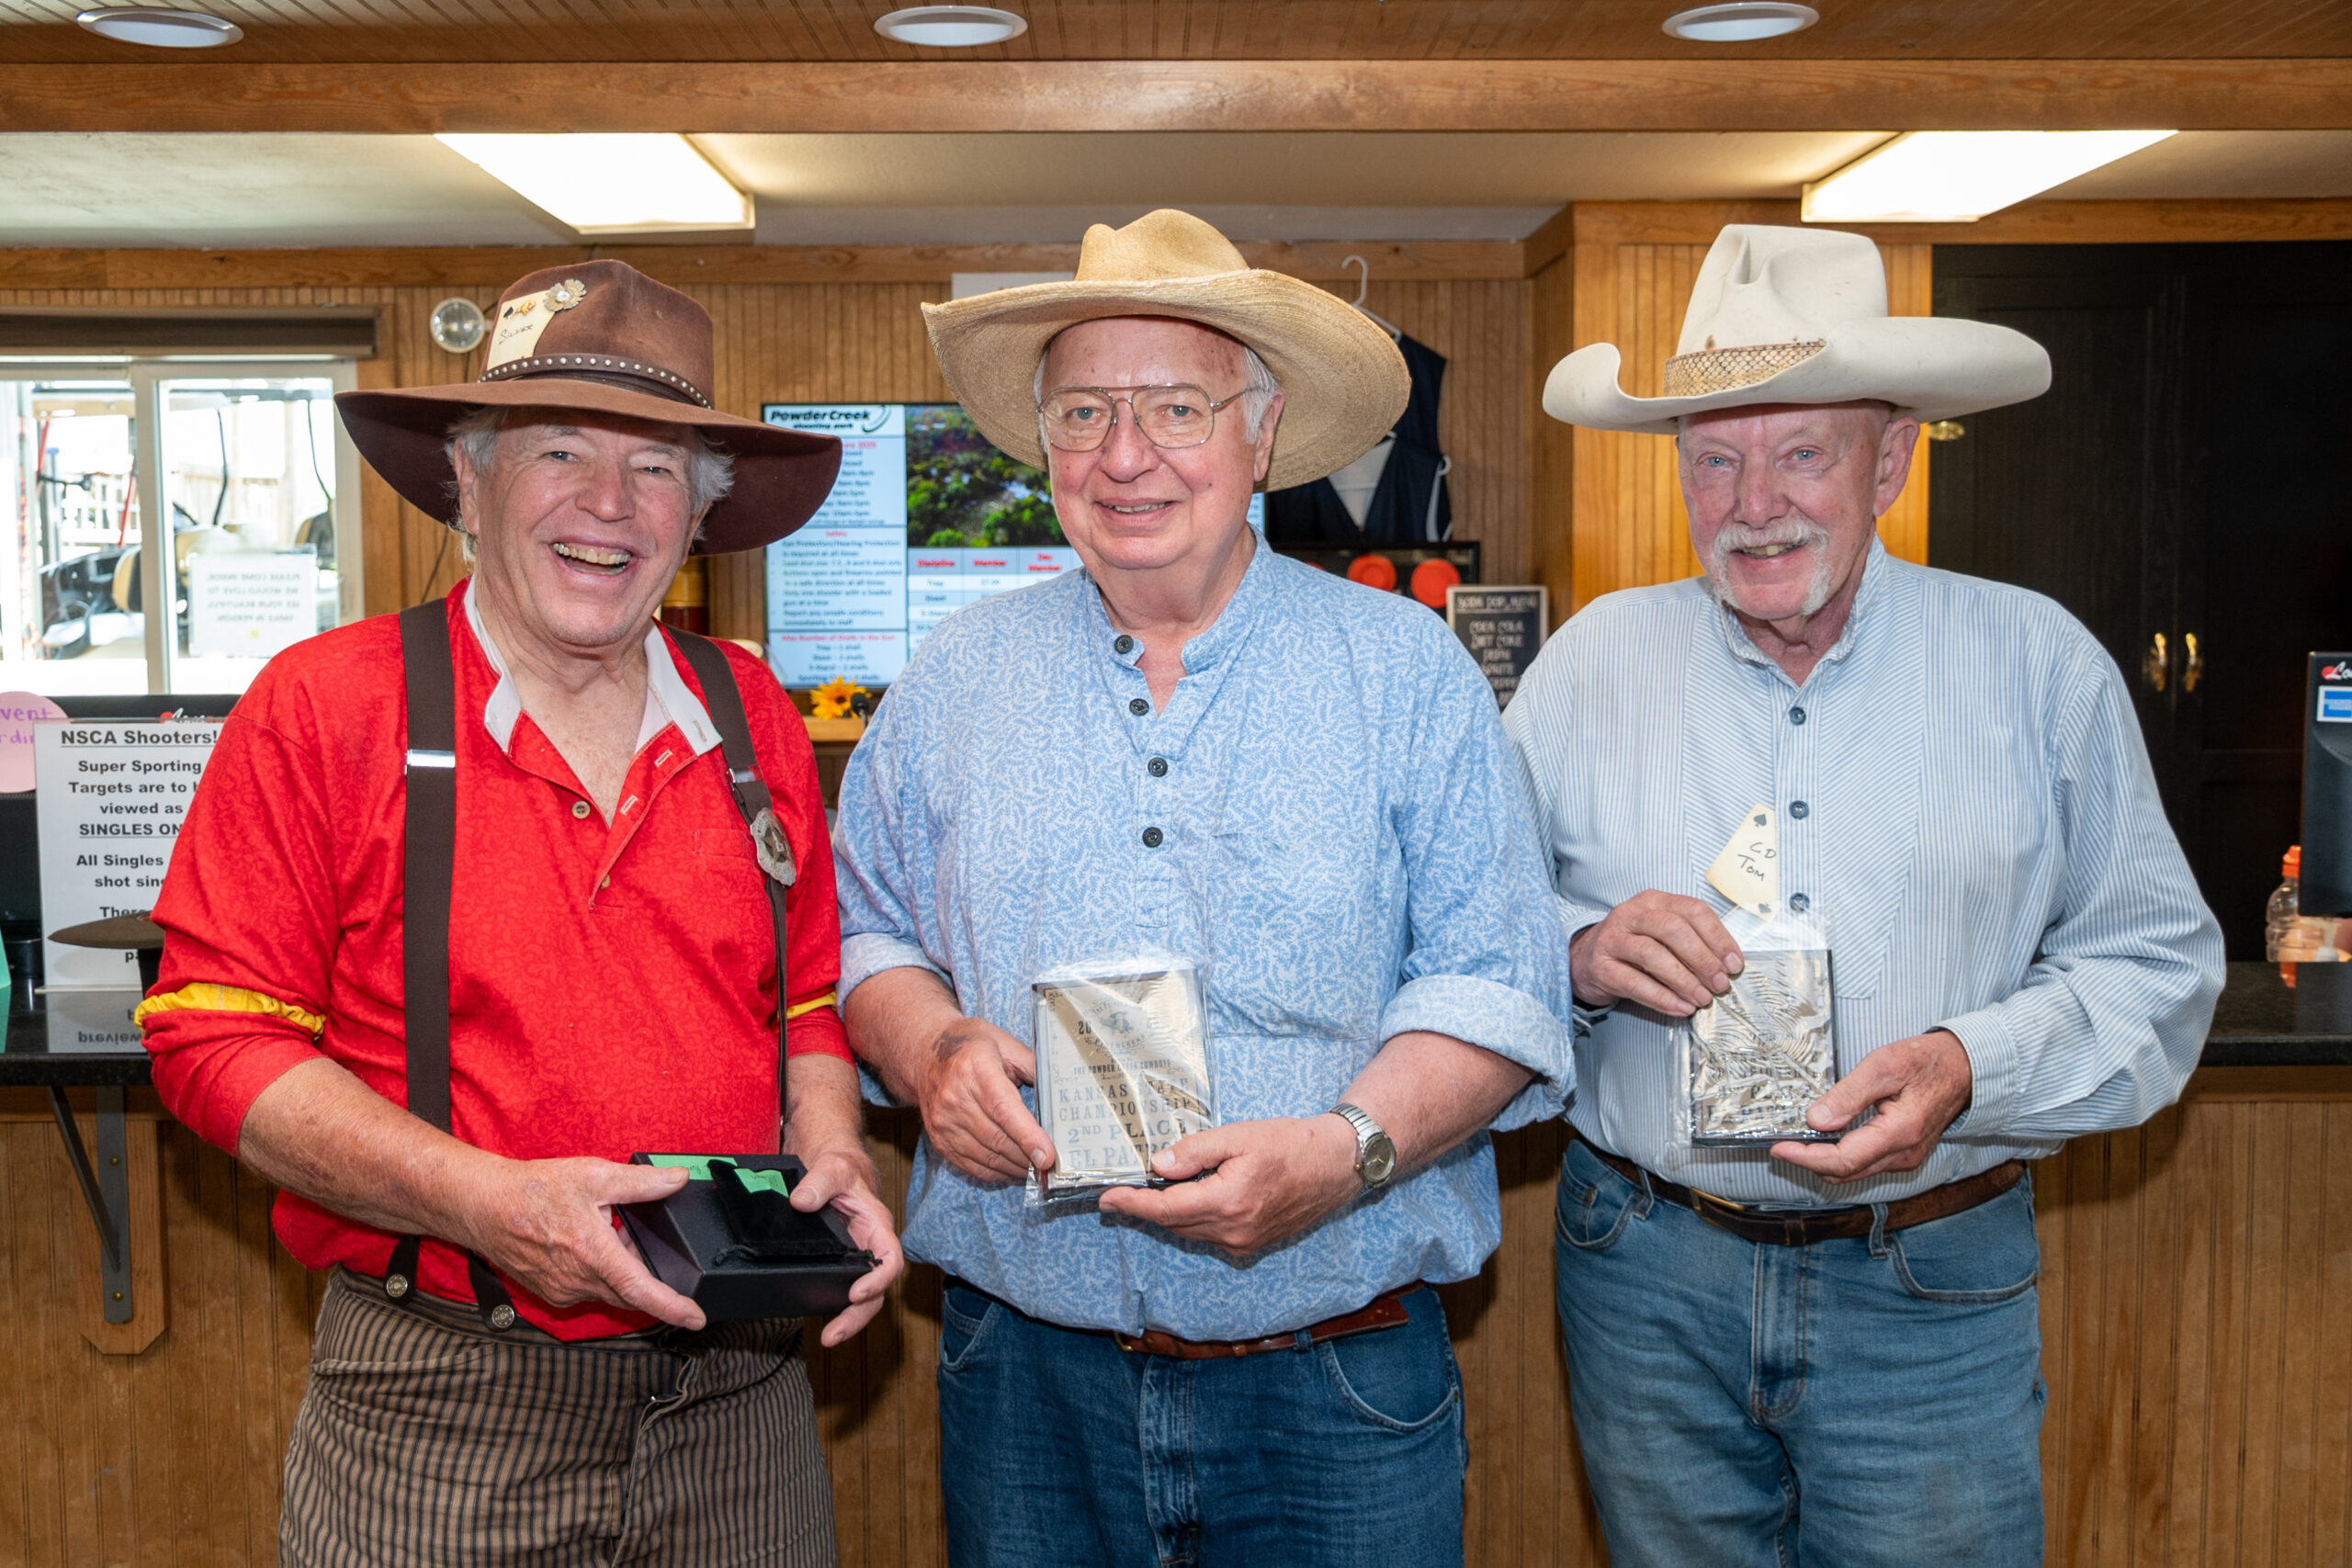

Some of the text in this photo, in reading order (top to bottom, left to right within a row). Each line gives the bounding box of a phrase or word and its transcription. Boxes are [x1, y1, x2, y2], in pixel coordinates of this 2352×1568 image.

[0, 707, 52, 721] vent
[61, 730, 218, 745] NSCA Shooters!
[78, 760, 202, 775] Super Sporting
[68, 782, 133, 796] Targets
[139, 784, 165, 794] are
[170, 783, 187, 794] to
[100, 803, 184, 815] viewed as
[79, 823, 184, 836] SINGLES ON
[76, 854, 164, 869] All Singles
[95, 875, 130, 887] shot
[1088, 1064, 1115, 1075] POWDER
[1059, 1083, 1128, 1103] KANSAS
[1068, 1118, 1187, 1144] 2ND PLACE
[1069, 1149, 1096, 1170] EL
